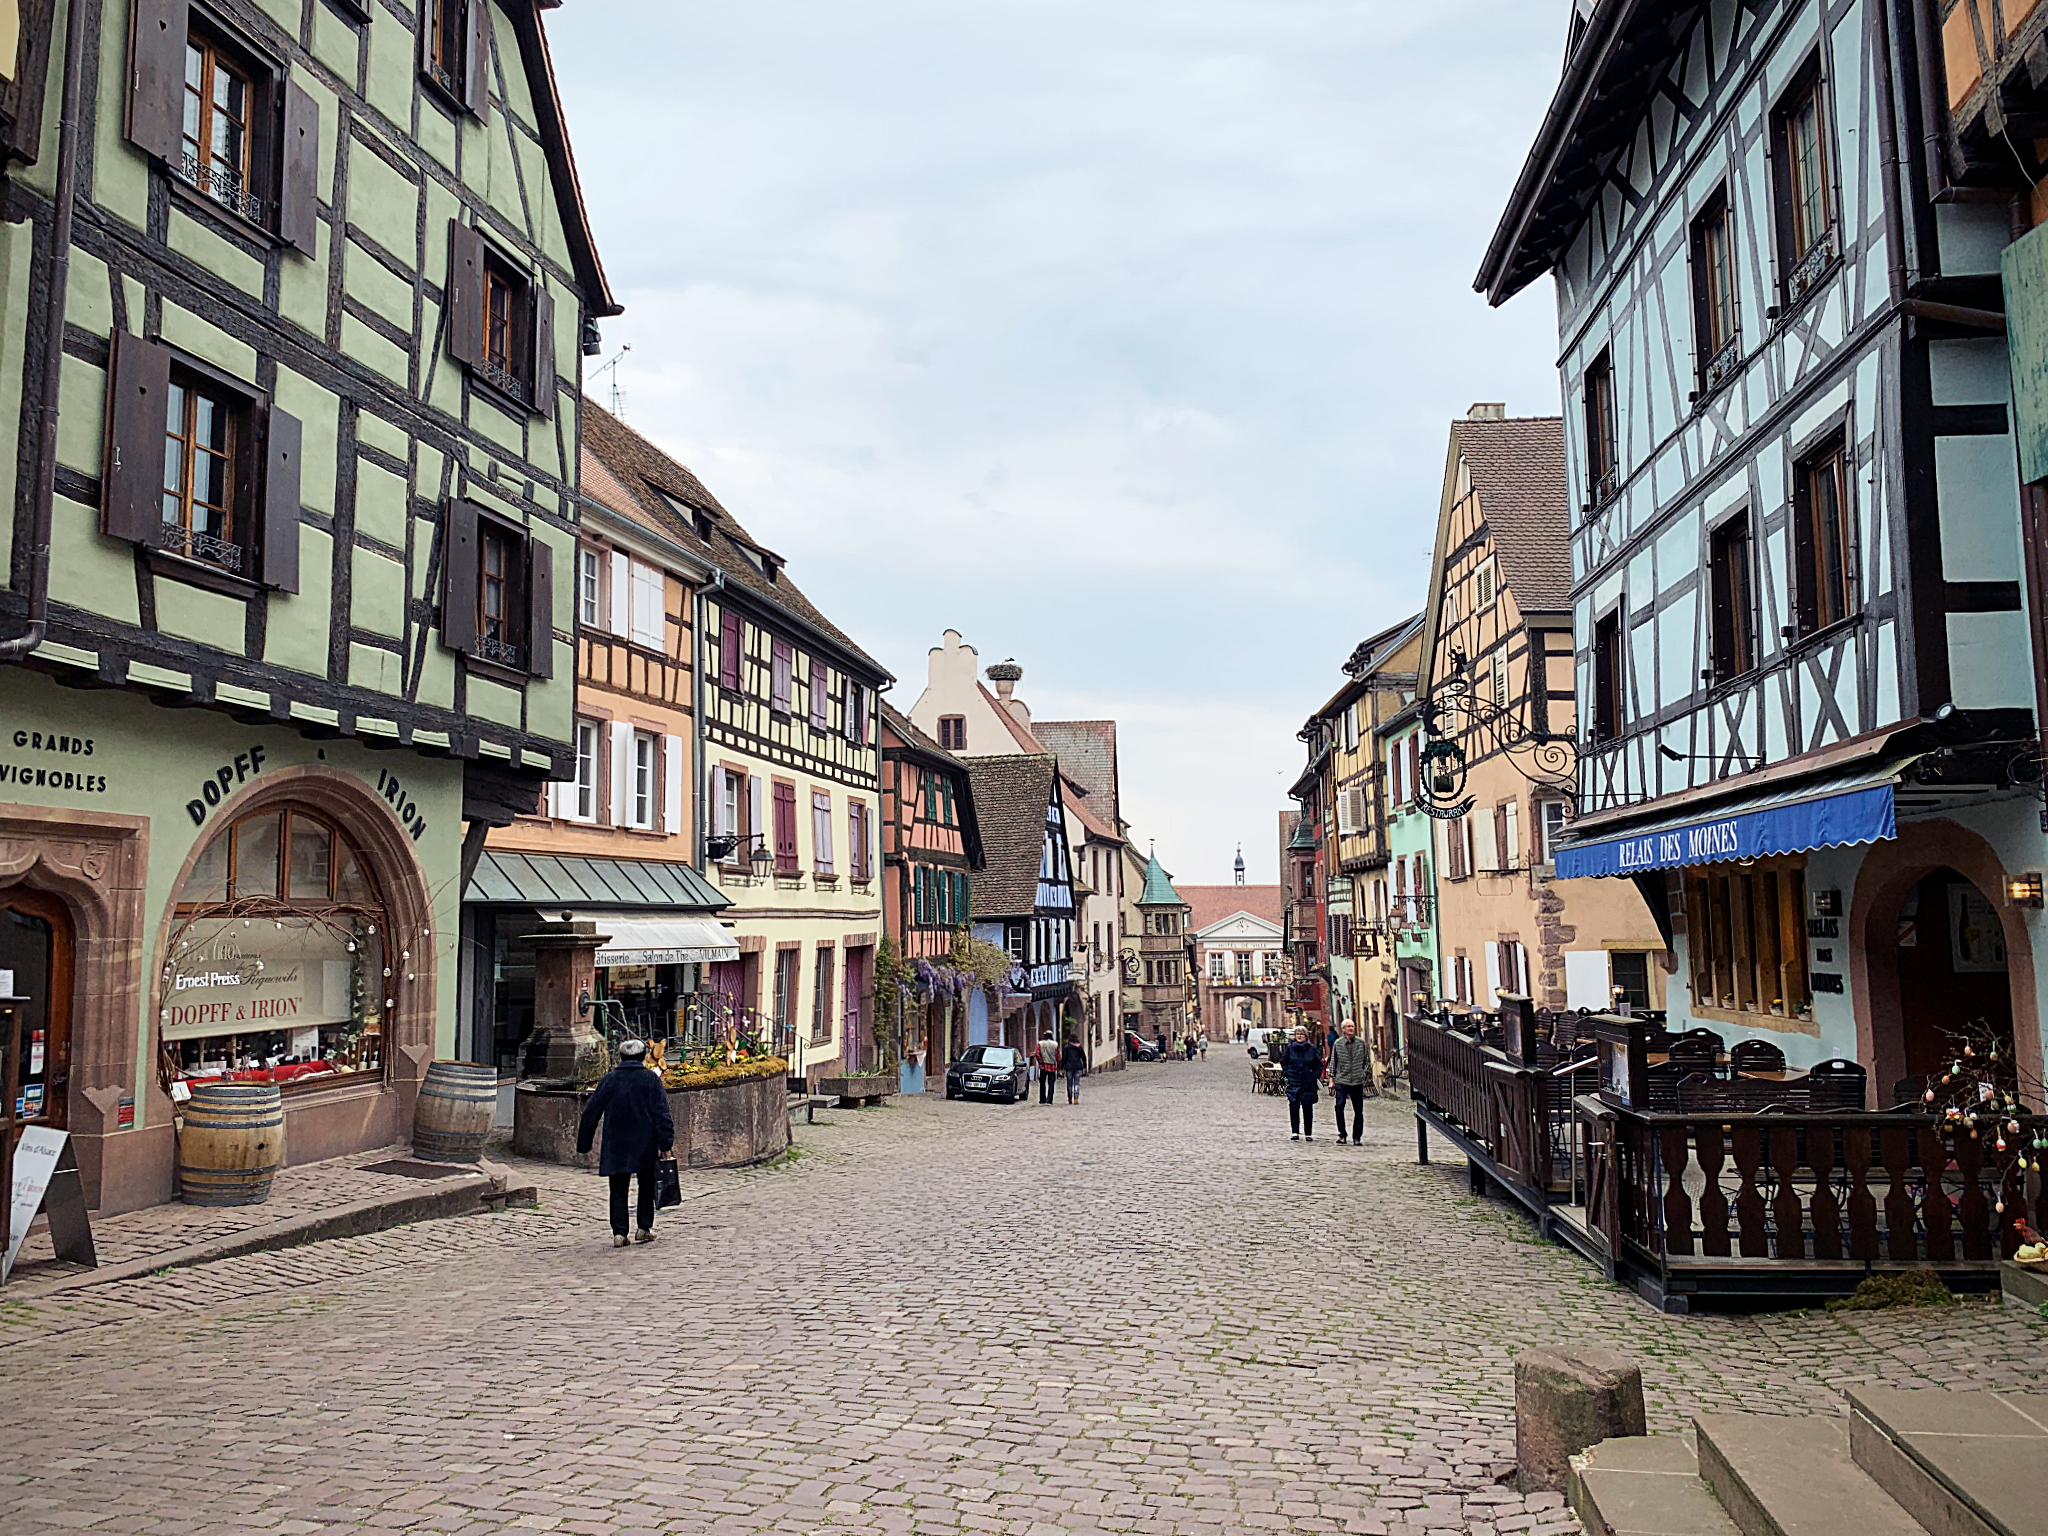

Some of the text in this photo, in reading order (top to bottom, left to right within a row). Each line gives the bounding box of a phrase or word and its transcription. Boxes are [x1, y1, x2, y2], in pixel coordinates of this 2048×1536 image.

[13, 730, 94, 756] GRANDS
[0, 763, 107, 792] VIGNOBLES
[185, 745, 266, 826] DOPFF
[377, 768, 427, 840] IRION
[1420, 803, 1467, 818] RESTAURANT
[1619, 821, 1738, 867] RELAIS DES MOINES
[1807, 918, 1839, 938] RELAIS
[595, 952, 630, 965] âtisserie
[642, 950, 663, 962] Salon
[664, 950, 674, 962] de
[699, 948, 729, 960] VILMAIN
[175, 971, 240, 990] Ernest Preiss
[170, 1003, 232, 1026] DOPFF
[235, 1005, 247, 1020] &
[21, 1143, 32, 1153] Vins
